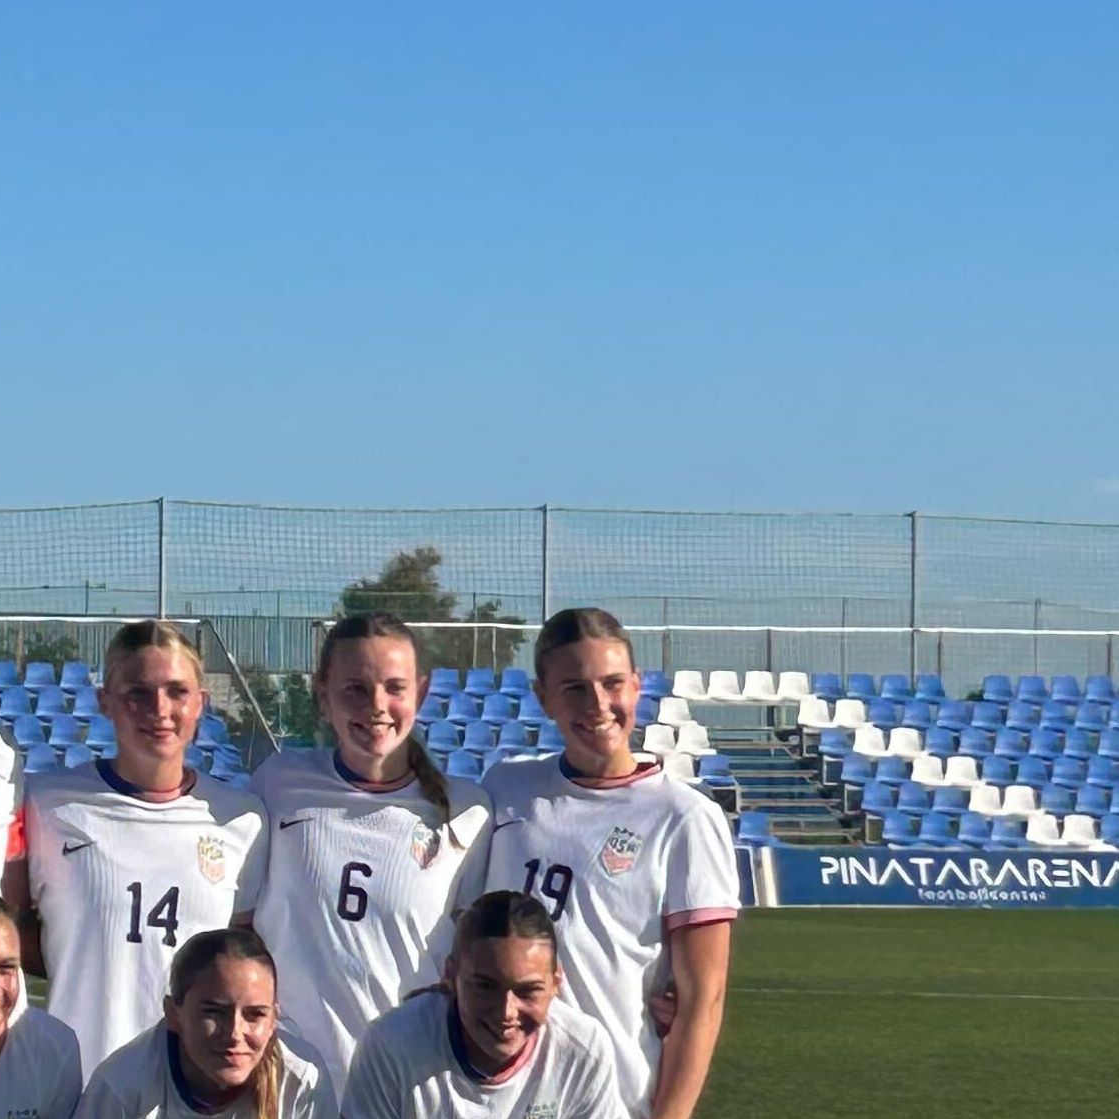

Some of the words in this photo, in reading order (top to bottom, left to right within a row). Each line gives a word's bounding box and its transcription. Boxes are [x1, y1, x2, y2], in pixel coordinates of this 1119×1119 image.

[126, 881, 180, 946] 14
[337, 861, 373, 922] 6
[524, 859, 574, 922] 19
